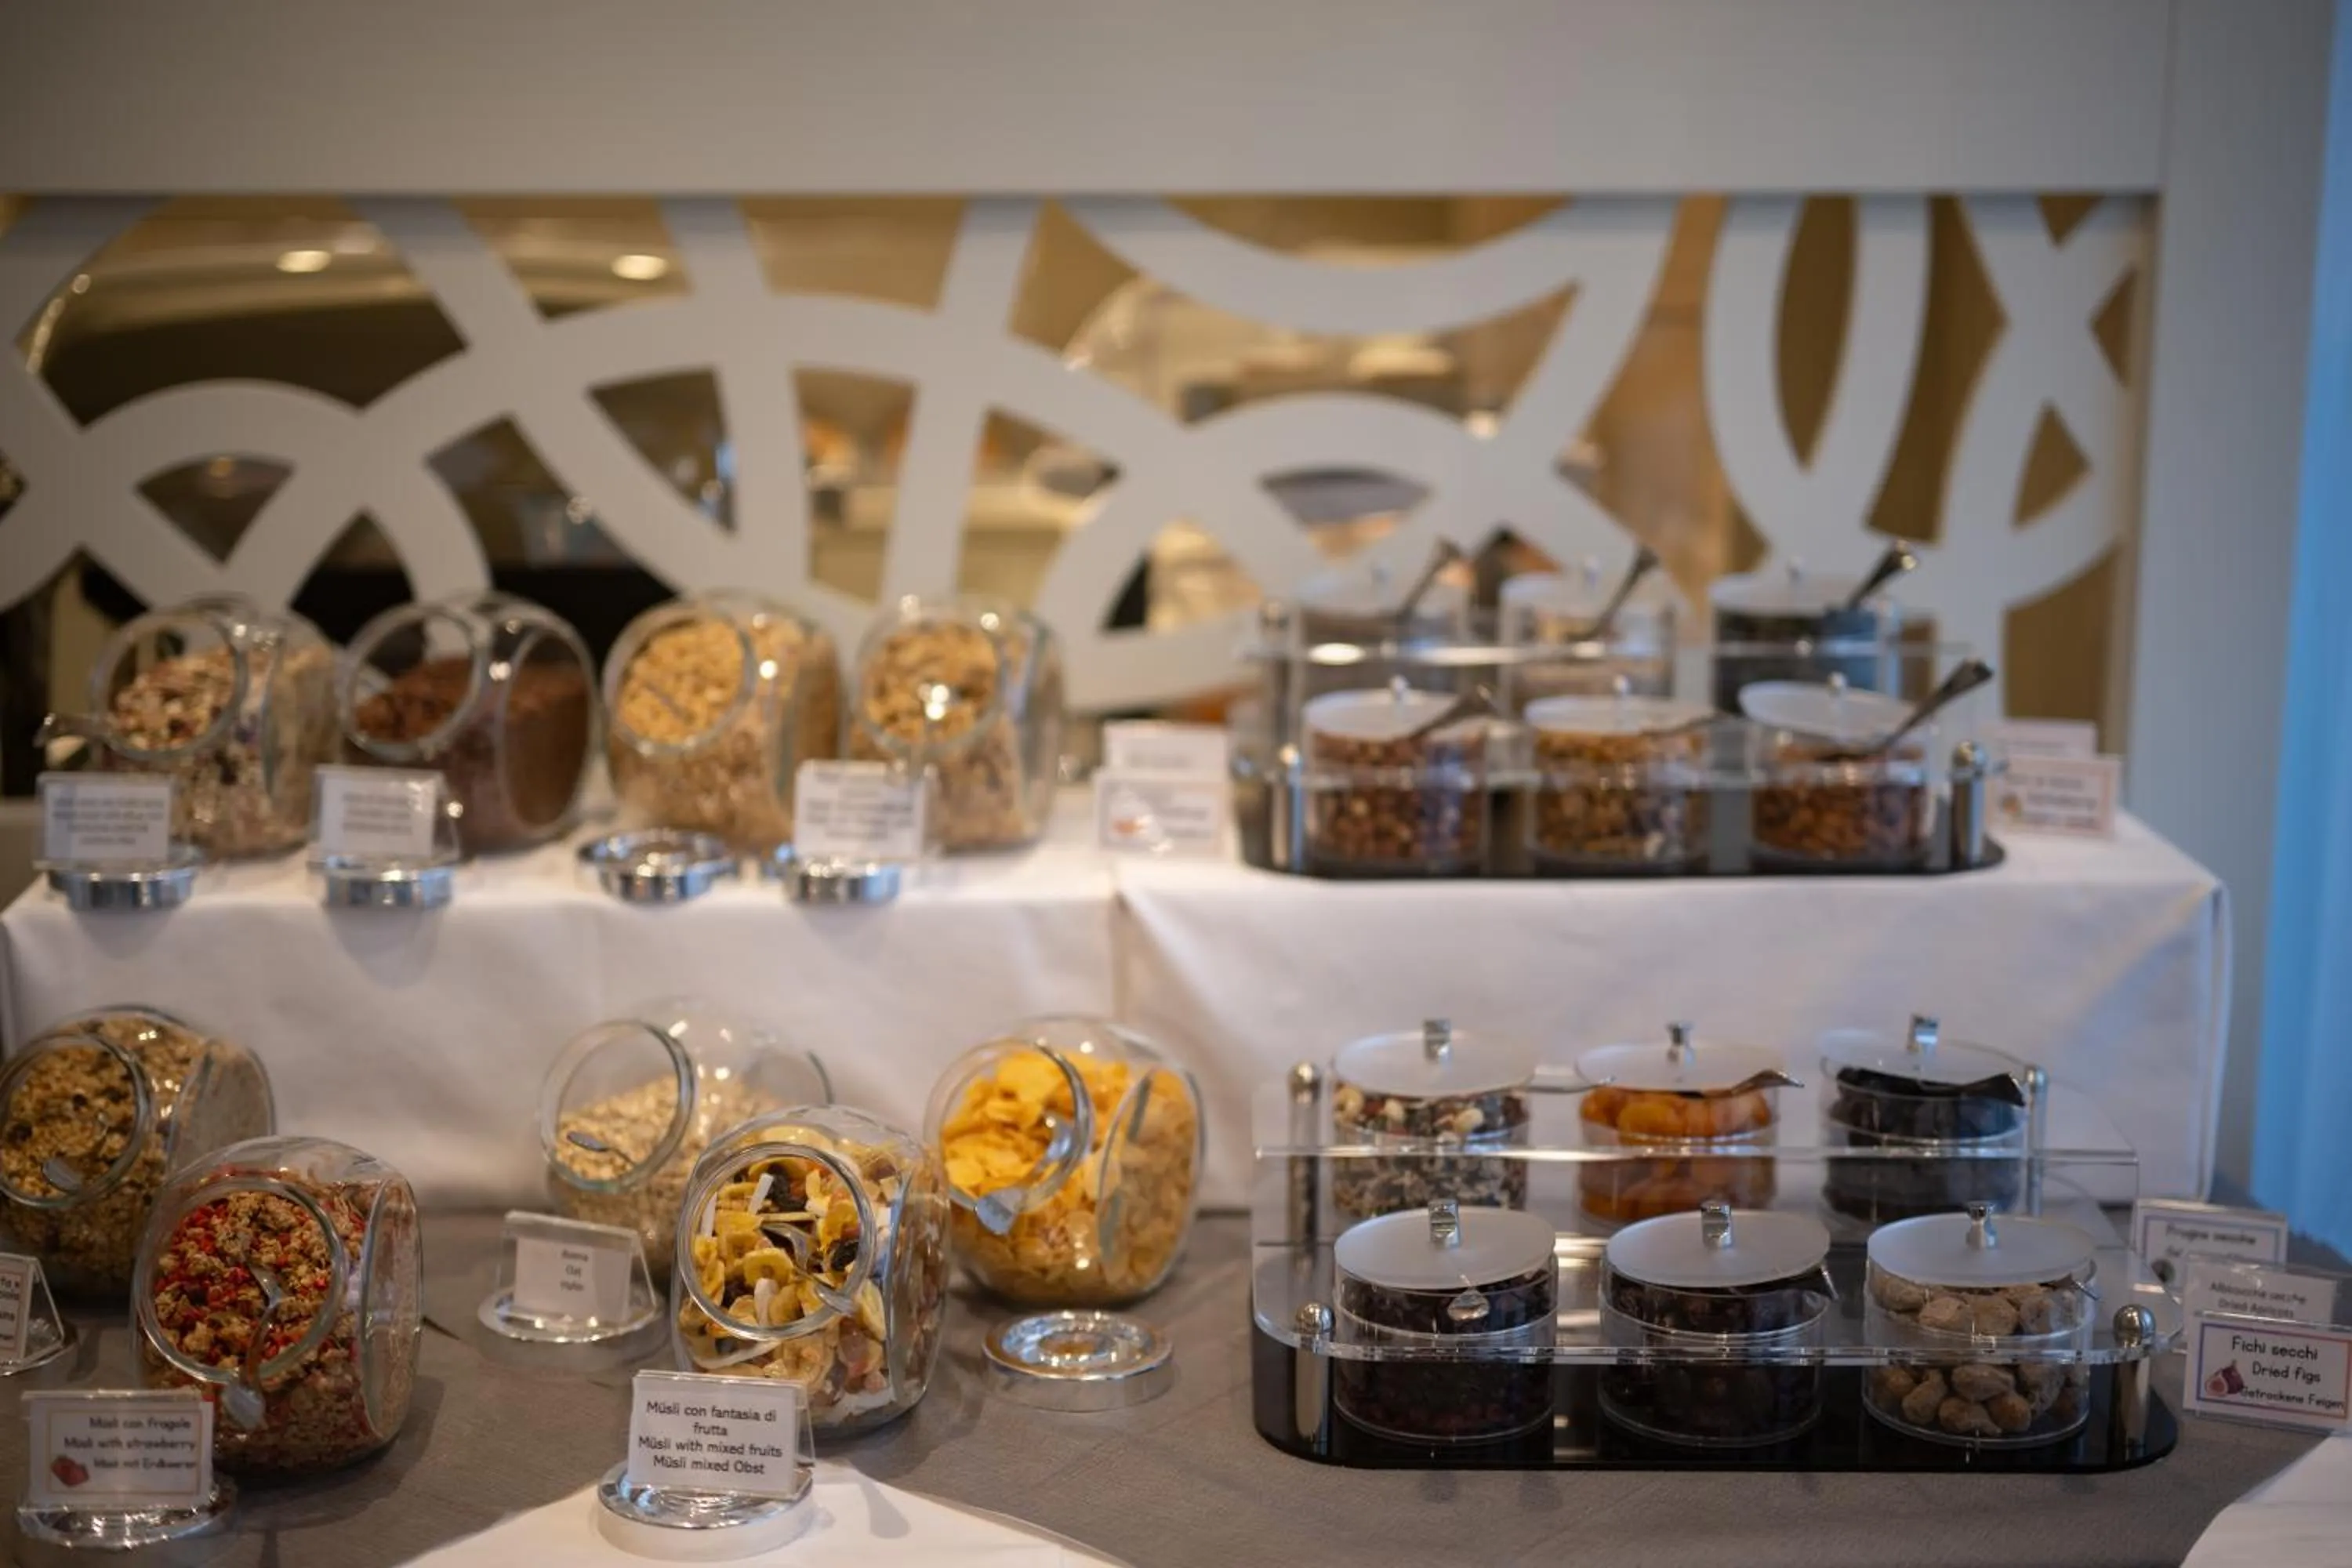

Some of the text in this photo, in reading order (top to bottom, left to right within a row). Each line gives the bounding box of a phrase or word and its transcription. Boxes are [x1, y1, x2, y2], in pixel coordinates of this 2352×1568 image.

[2232, 1335, 2318, 1360] Fichi secchi
[2252, 1361, 2321, 1385] Dried figs
[647, 1401, 776, 1421] Müsli con fantasia di
[694, 1422, 728, 1436] frutta
[638, 1436, 782, 1457] Müsli with mixed fruits
[653, 1455, 765, 1475] Müsli mixed Obst
